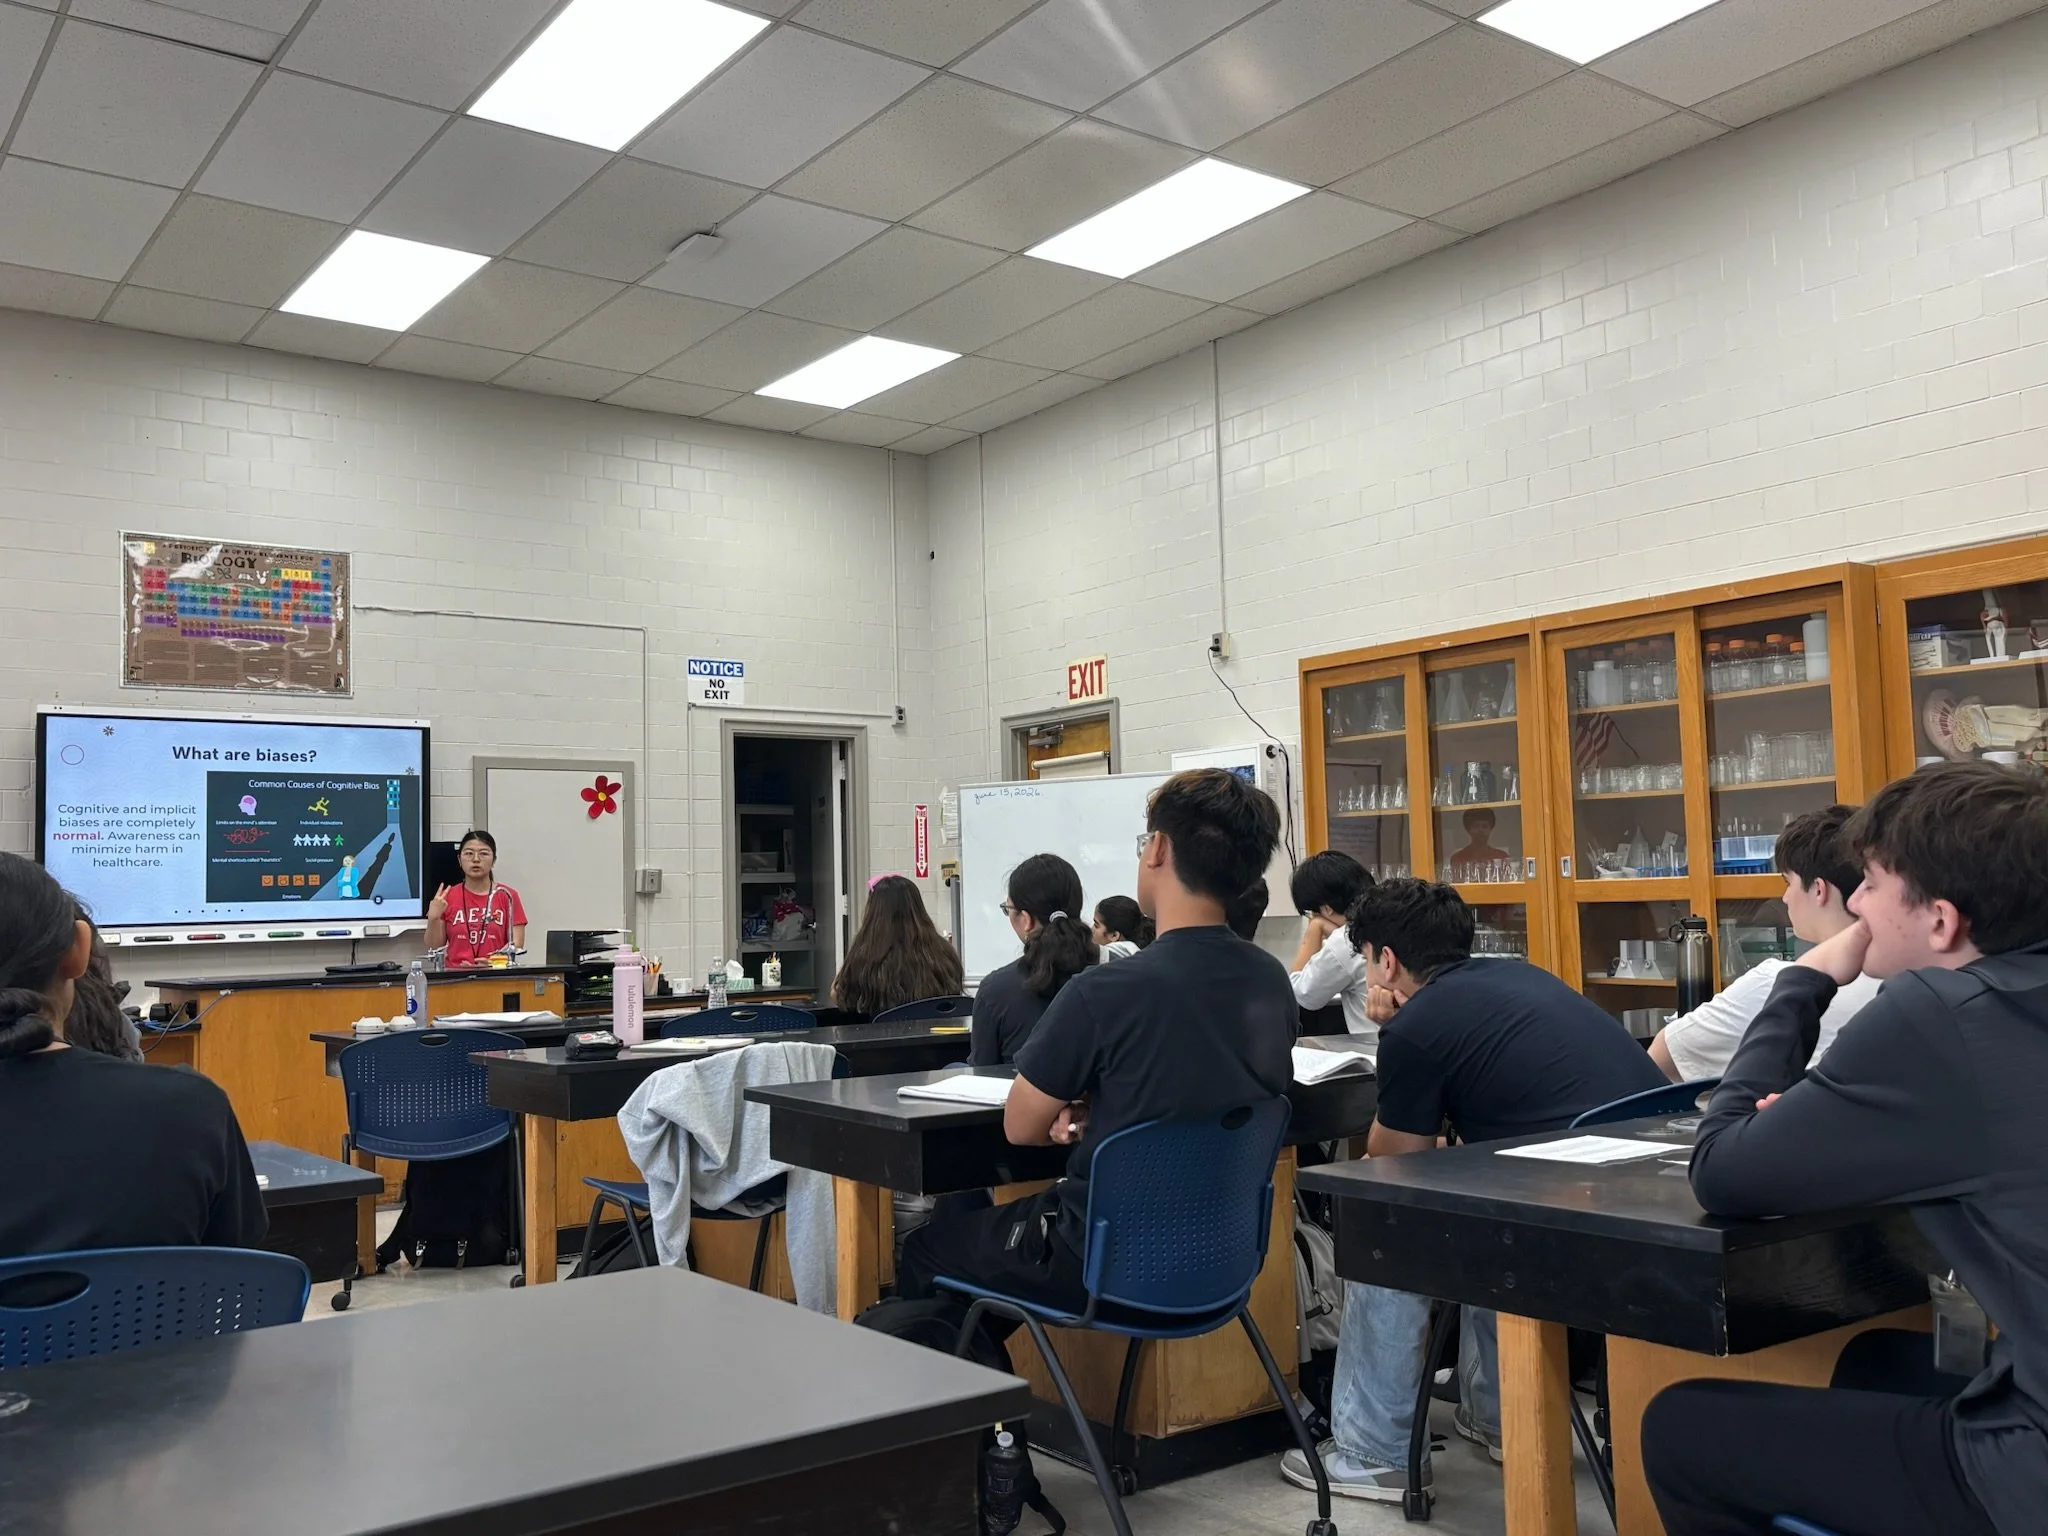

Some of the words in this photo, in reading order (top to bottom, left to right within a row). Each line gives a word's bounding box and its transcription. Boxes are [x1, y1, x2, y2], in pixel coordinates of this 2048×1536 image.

[690, 660, 743, 677] NOTICE
[709, 679, 725, 688] NO
[1068, 659, 1105, 700] EXIT
[704, 689, 730, 700] EXIT
[172, 746, 219, 761] What
[224, 751, 250, 761] are
[256, 748, 317, 763] biases?
[248, 779, 286, 789] Common
[286, 780, 315, 789] Causes
[315, 781, 325, 789] of
[326, 781, 364, 791] Cognitive
[363, 781, 380, 790] Bias
[58, 804, 120, 815] Cognitive
[122, 804, 147, 814] and
[150, 804, 197, 816] implicit
[59, 817, 100, 827] biases
[103, 819, 123, 827] are
[126, 818, 196, 829] completely
[53, 831, 104, 840] normal.
[107, 831, 178, 841] Awareness
[178, 832, 201, 841] can
[71, 844, 132, 854] minimize
[135, 844, 169, 854] harm
[172, 843, 184, 854] in
[93, 858, 163, 868] healthcare.
[627, 984, 636, 1029] lululemon
